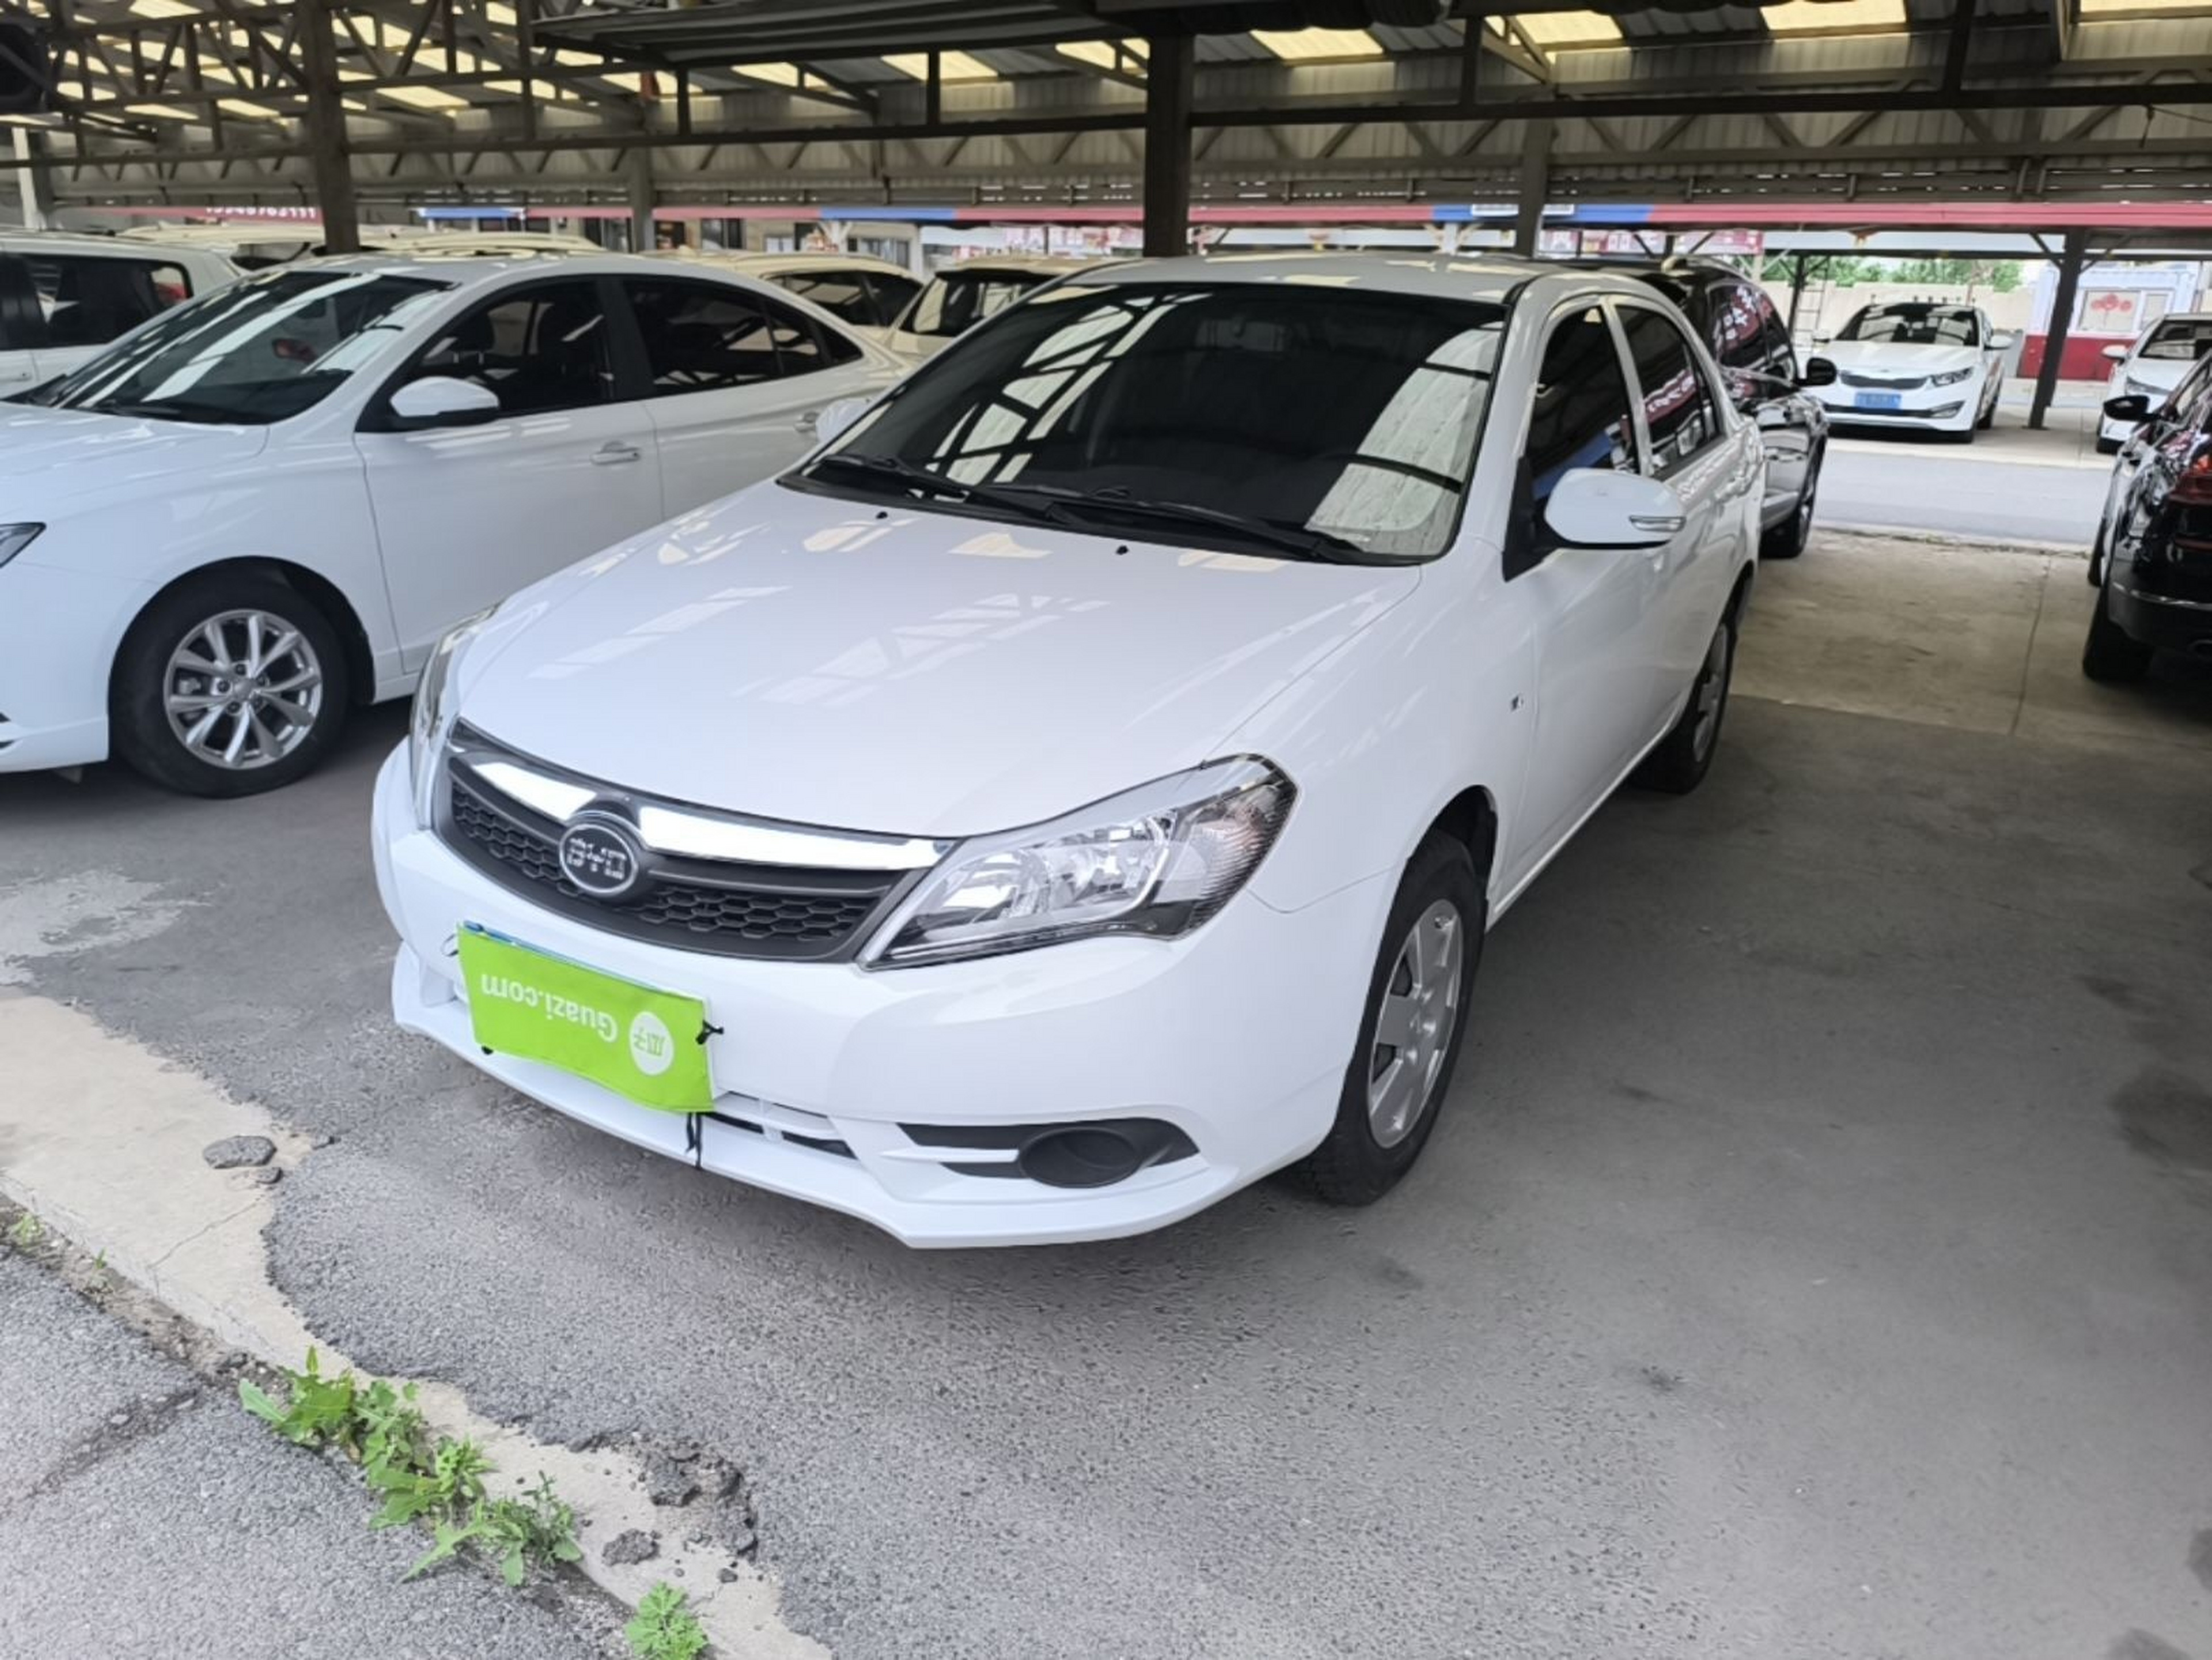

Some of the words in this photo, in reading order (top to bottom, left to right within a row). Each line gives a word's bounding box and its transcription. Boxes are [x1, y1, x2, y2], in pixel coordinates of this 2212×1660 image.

[567, 838, 626, 880] BYD
[482, 974, 618, 1042] Guazi.com
[634, 1027, 665, 1056] 瓜子
